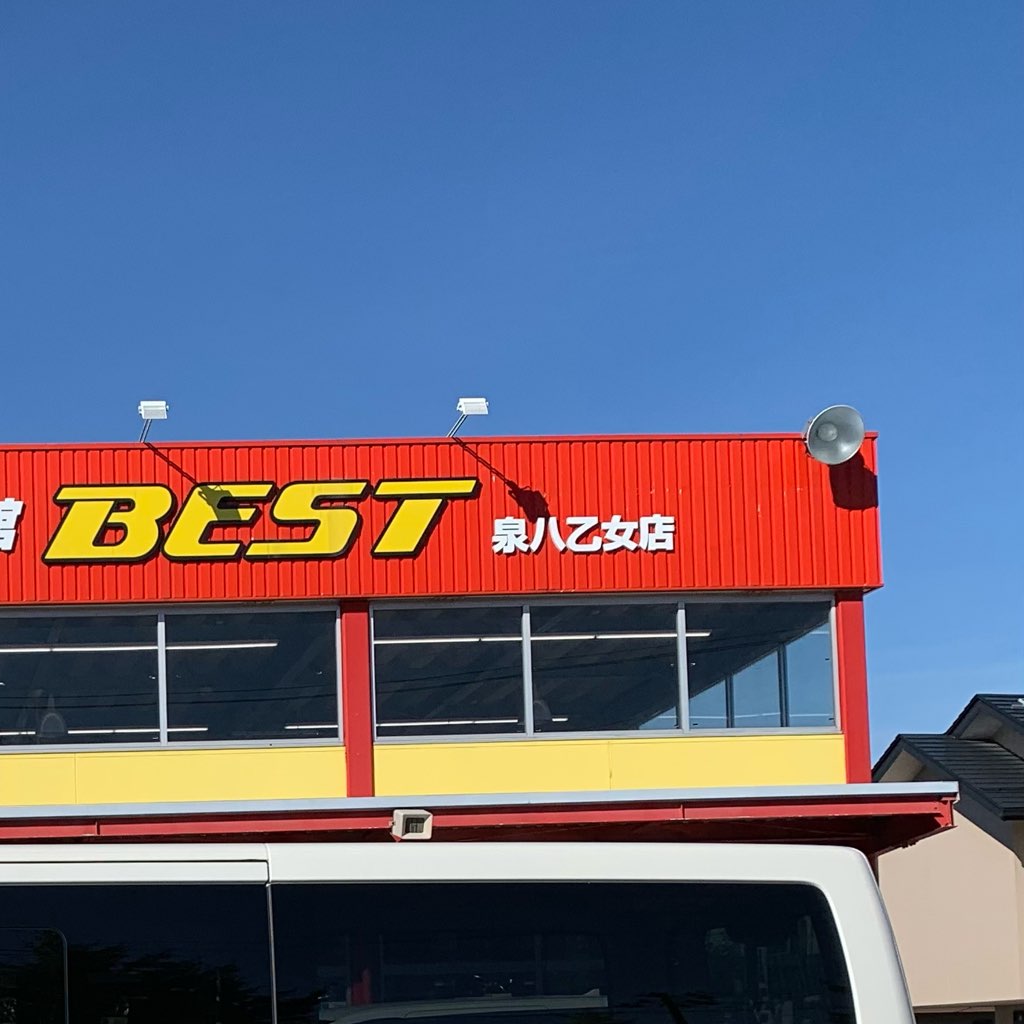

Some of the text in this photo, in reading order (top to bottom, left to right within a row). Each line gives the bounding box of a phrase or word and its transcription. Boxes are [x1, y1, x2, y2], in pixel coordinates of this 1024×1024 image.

[42, 477, 482, 565] BEST
[491, 513, 676, 554] 泉八乙女店
